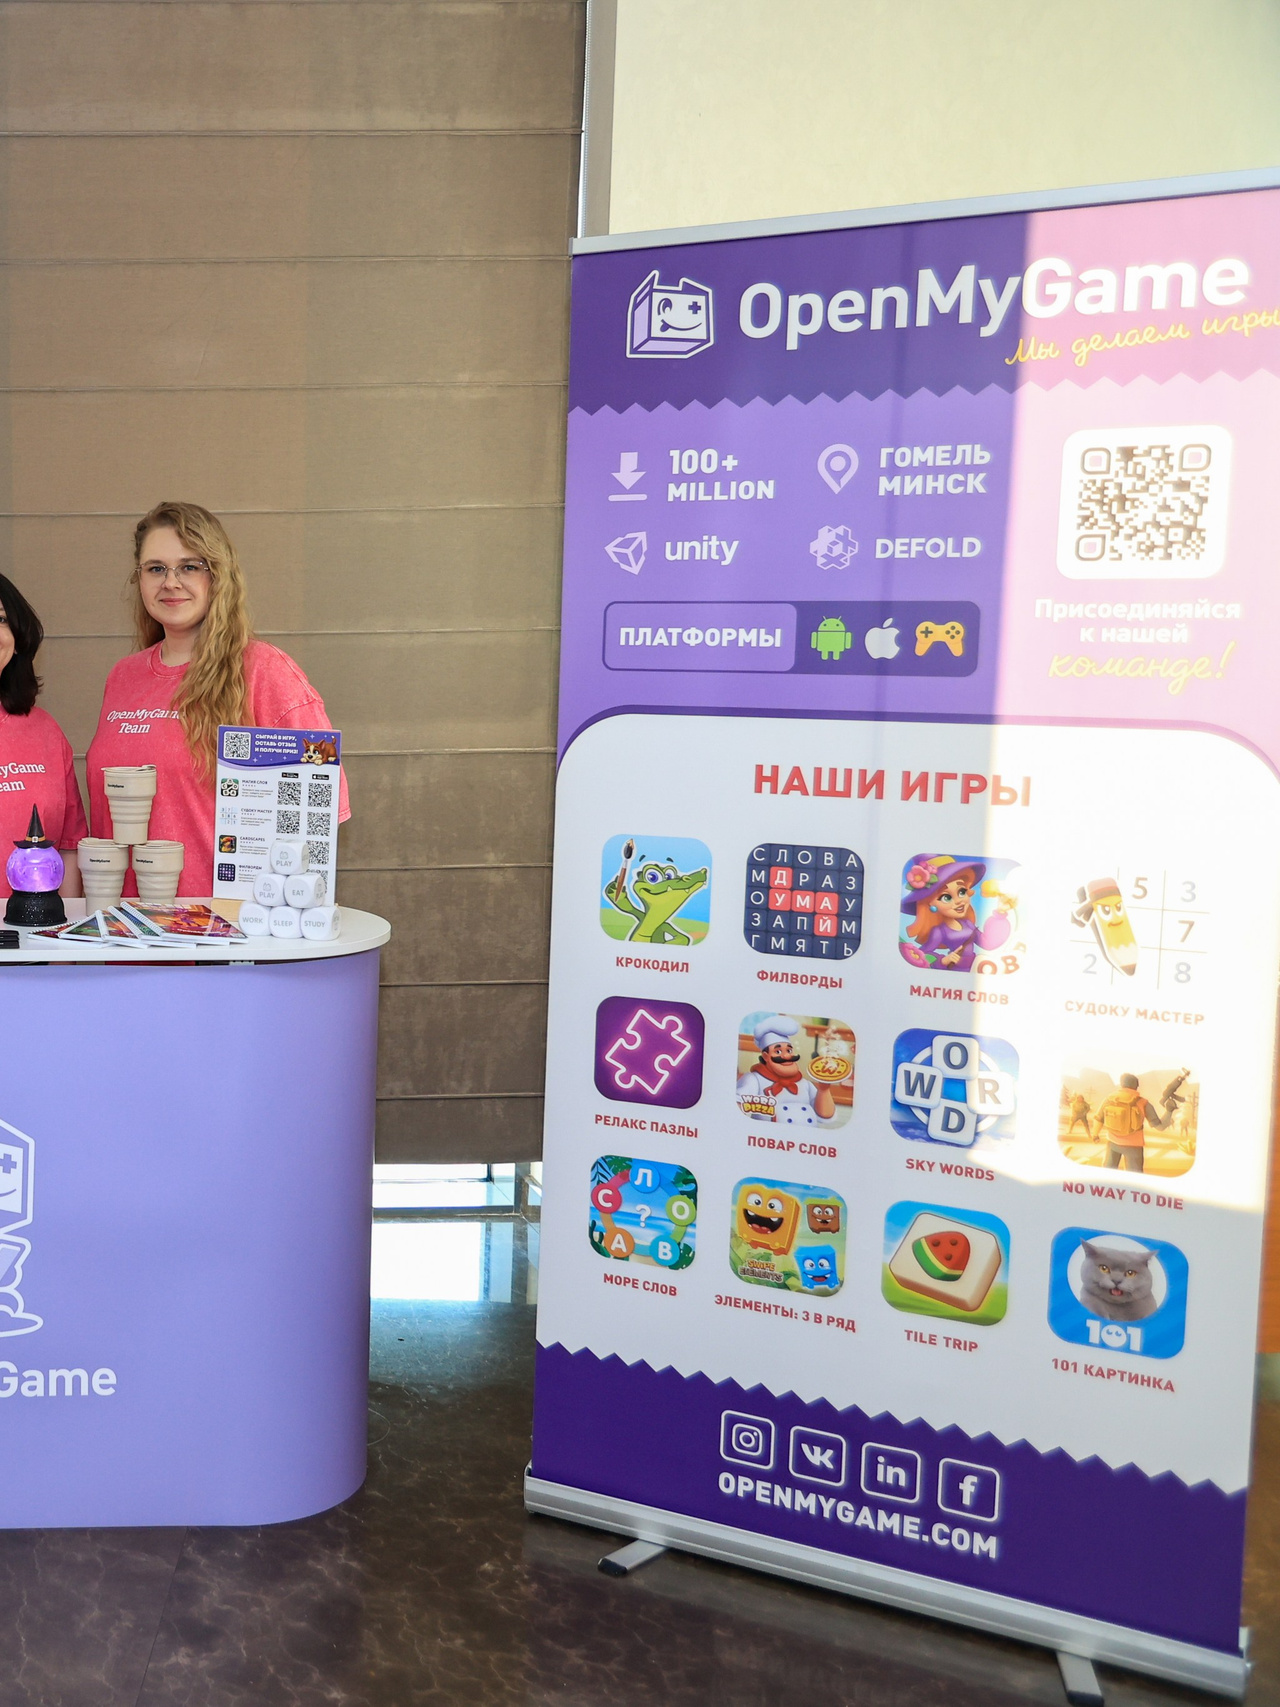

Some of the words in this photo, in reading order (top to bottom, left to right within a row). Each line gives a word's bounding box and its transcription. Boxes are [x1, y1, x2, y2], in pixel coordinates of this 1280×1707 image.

[738, 256, 1250, 352] OpenMyGame
[1005, 336, 1060, 366] Мы
[1071, 323, 1190, 367] делаем
[669, 448, 739, 476] 100+
[879, 444, 991, 470] ГОМЕЛЬ
[667, 479, 775, 503] MILLION
[878, 472, 986, 497] МИНСК
[664, 534, 739, 566] unity
[875, 536, 981, 559] DEFOLD
[1034, 597, 1242, 621] Присоединяйся
[619, 626, 781, 649] ПЛАТФОРМЫ
[1080, 626, 1094, 643] к
[1102, 622, 1188, 645] нашей
[1047, 641, 1236, 696] команде!
[118, 723, 150, 733] Team
[754, 764, 885, 800] НАШИ
[900, 769, 1032, 808] ИГРЫ
[1131, 876, 1148, 900] 5
[1180, 881, 1197, 903] 3
[1178, 920, 1195, 943] 7
[615, 956, 690, 974] КРОКОДИЛ
[1083, 953, 1098, 975] 2
[1174, 962, 1192, 983] 8
[756, 969, 843, 990] ФИЛВОРДЫ
[910, 984, 962, 1001] МАГИЯ
[967, 990, 1009, 1005] СЛОВ
[1065, 1000, 1130, 1017] СУДОКУ
[1135, 1009, 1205, 1026] МАСТЕР
[942, 1041, 969, 1070] O
[904, 1069, 937, 1100] W
[979, 1078, 1001, 1105] R
[594, 1114, 647, 1135] РЕЛАКС
[650, 1119, 699, 1139] ПАЗЛЫ
[941, 1106, 966, 1133] D
[747, 1135, 795, 1152] ПОВАР
[799, 1143, 837, 1158] СЛОВ
[905, 1158, 935, 1173] SKY
[939, 1162, 995, 1181] WORDS
[1062, 1181, 1085, 1195] NO
[1089, 1184, 1126, 1200] WAY
[1130, 1191, 1152, 1205] TO
[1155, 1195, 1184, 1210] DIE
[739, 1266, 784, 1284] ELEMENTS
[747, 1259, 776, 1272] SWIPE
[603, 1273, 638, 1289] МОРЕ
[642, 1280, 677, 1297] СЛОВ
[714, 1294, 799, 1320] ЭЛЕМЕНТЫ:
[802, 1311, 810, 1322] 3
[813, 1313, 822, 1324] В
[826, 1315, 856, 1333] РЯД
[904, 1329, 937, 1346] TILE
[944, 1335, 978, 1352] TRIP
[1086, 1319, 1142, 1352] 101
[1052, 1358, 1079, 1374] 101
[1083, 1364, 1175, 1393] КАРТИНКА
[718, 1471, 998, 1560] OPENMYGAME.COM
